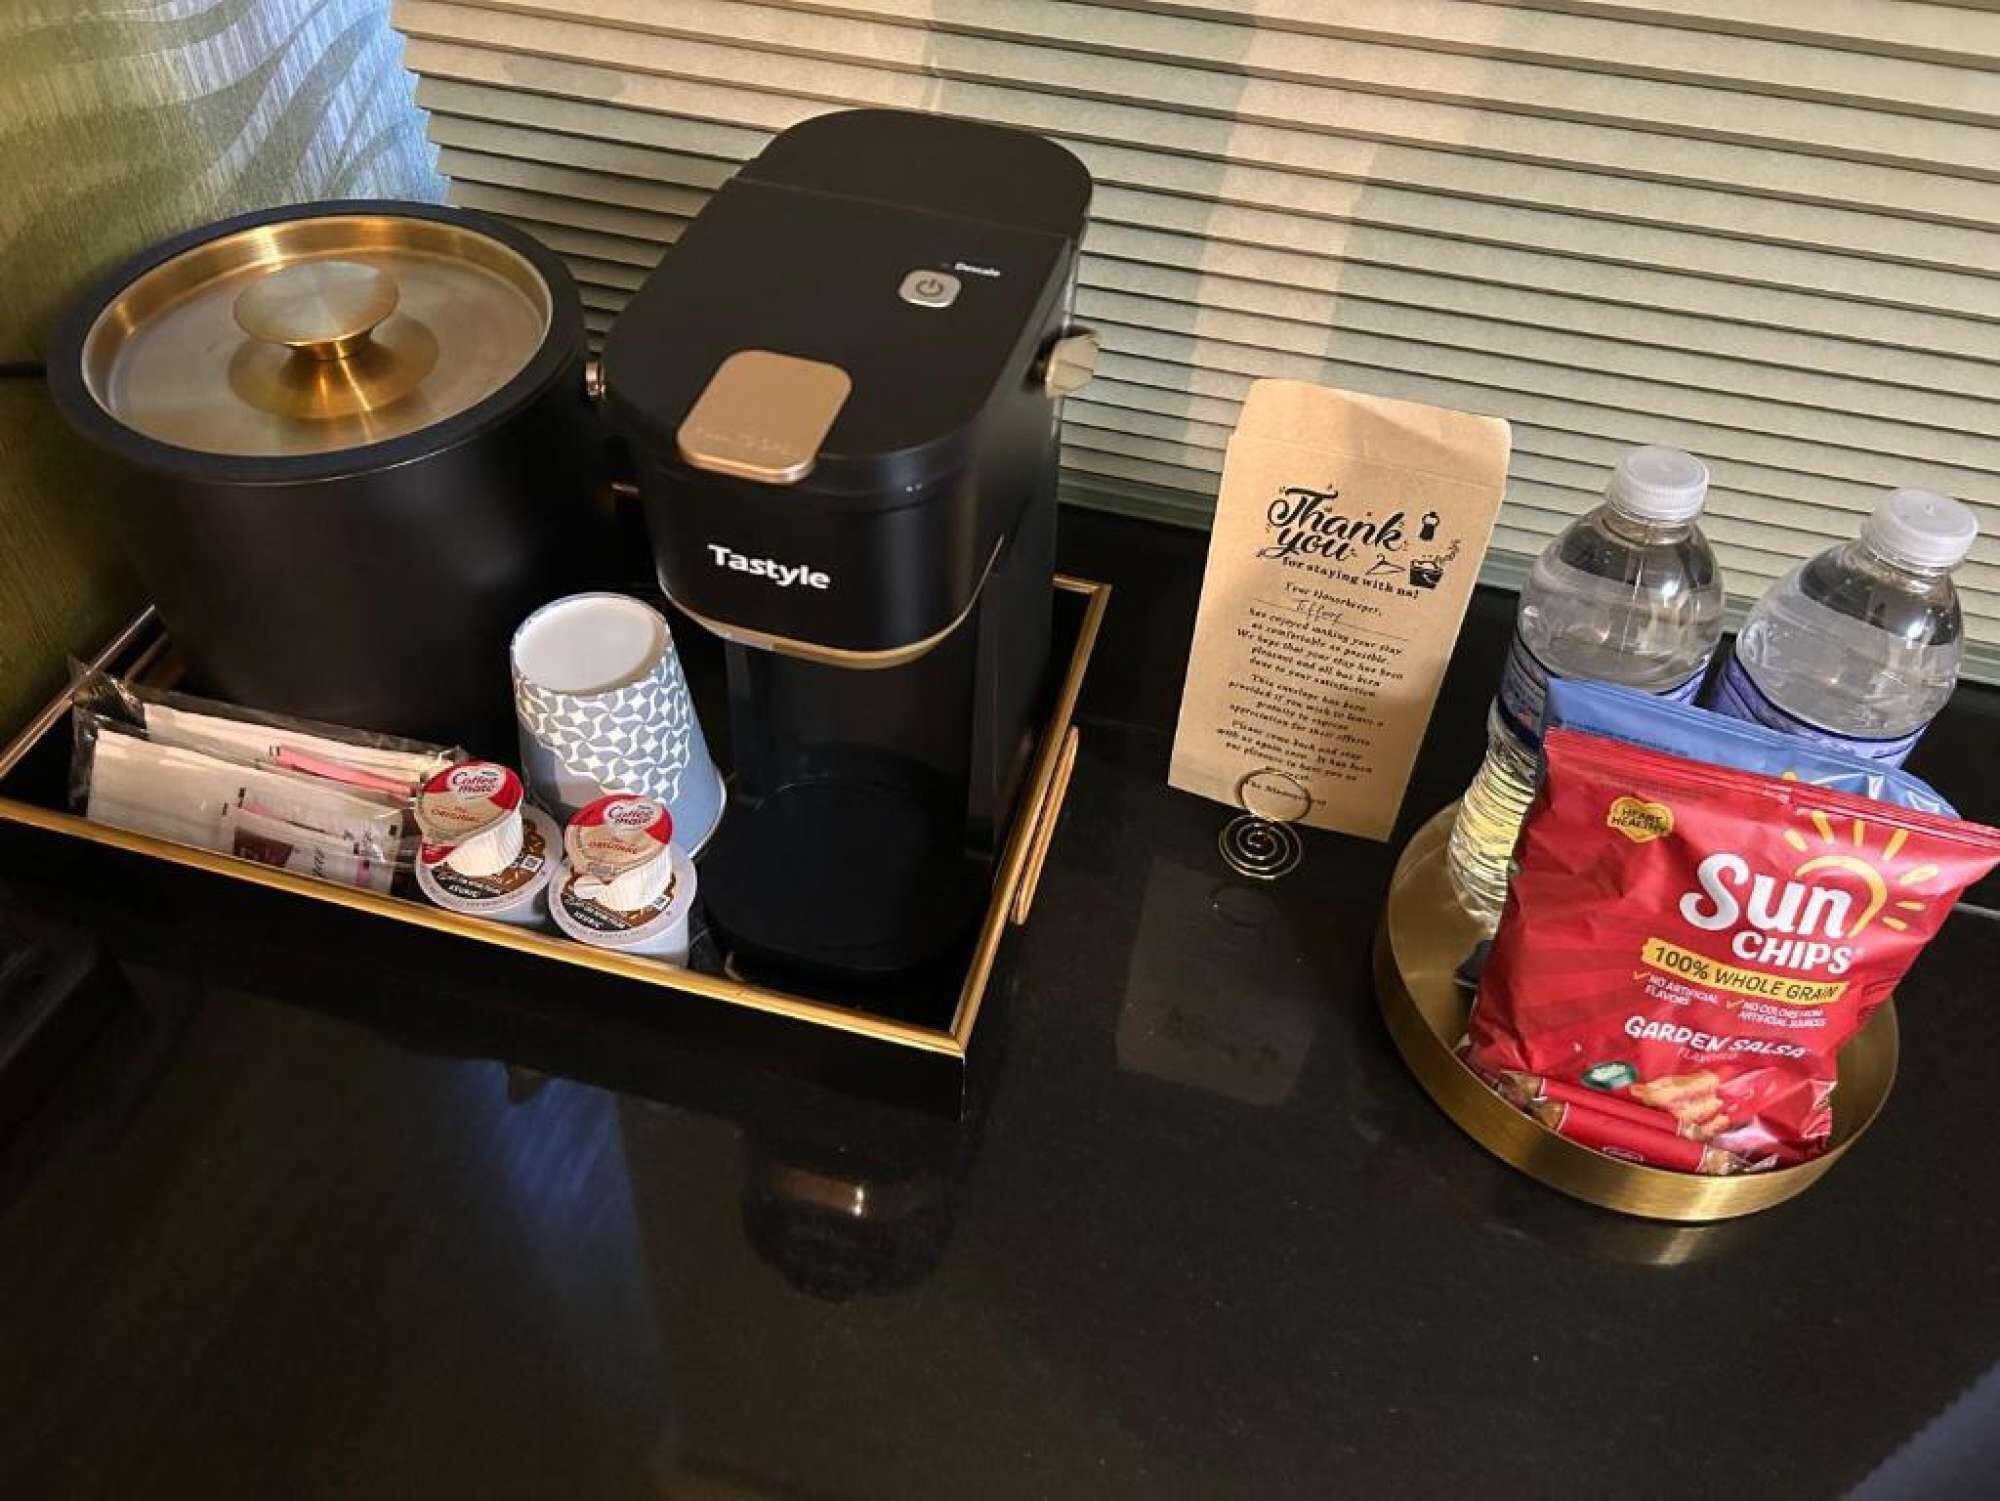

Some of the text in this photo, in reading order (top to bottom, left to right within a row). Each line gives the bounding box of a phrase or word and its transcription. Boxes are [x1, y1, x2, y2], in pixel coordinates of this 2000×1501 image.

[1267, 485, 1404, 551] Thank
[1256, 525, 1352, 563] you
[708, 544, 831, 591] Tastyle
[1282, 556, 1419, 599] for staying with us!
[1284, 581, 1309, 593] Your
[1237, 627, 1254, 639] We
[1380, 668, 1403, 679] been
[1266, 626, 1326, 647] comfortable
[1269, 615, 1308, 631] enjoyed
[1312, 626, 1349, 642] making
[1351, 638, 1375, 649] your
[1379, 643, 1402, 655] stay
[1252, 646, 1293, 662] pleasant
[1296, 659, 1314, 669] and
[453, 772, 497, 786] Coffee
[459, 783, 494, 793] mate
[608, 806, 654, 819] Coffee
[1622, 809, 1662, 821] HEART
[1679, 853, 1852, 938] Sun
[1732, 931, 1852, 974] CHIPS
[1649, 974, 1669, 989] NO
[1654, 946, 1840, 1004] 100% WHOLE GRAIN
[1743, 1002, 1763, 1015] NO
[1624, 1016, 1808, 1059] GARDEN SALSA
